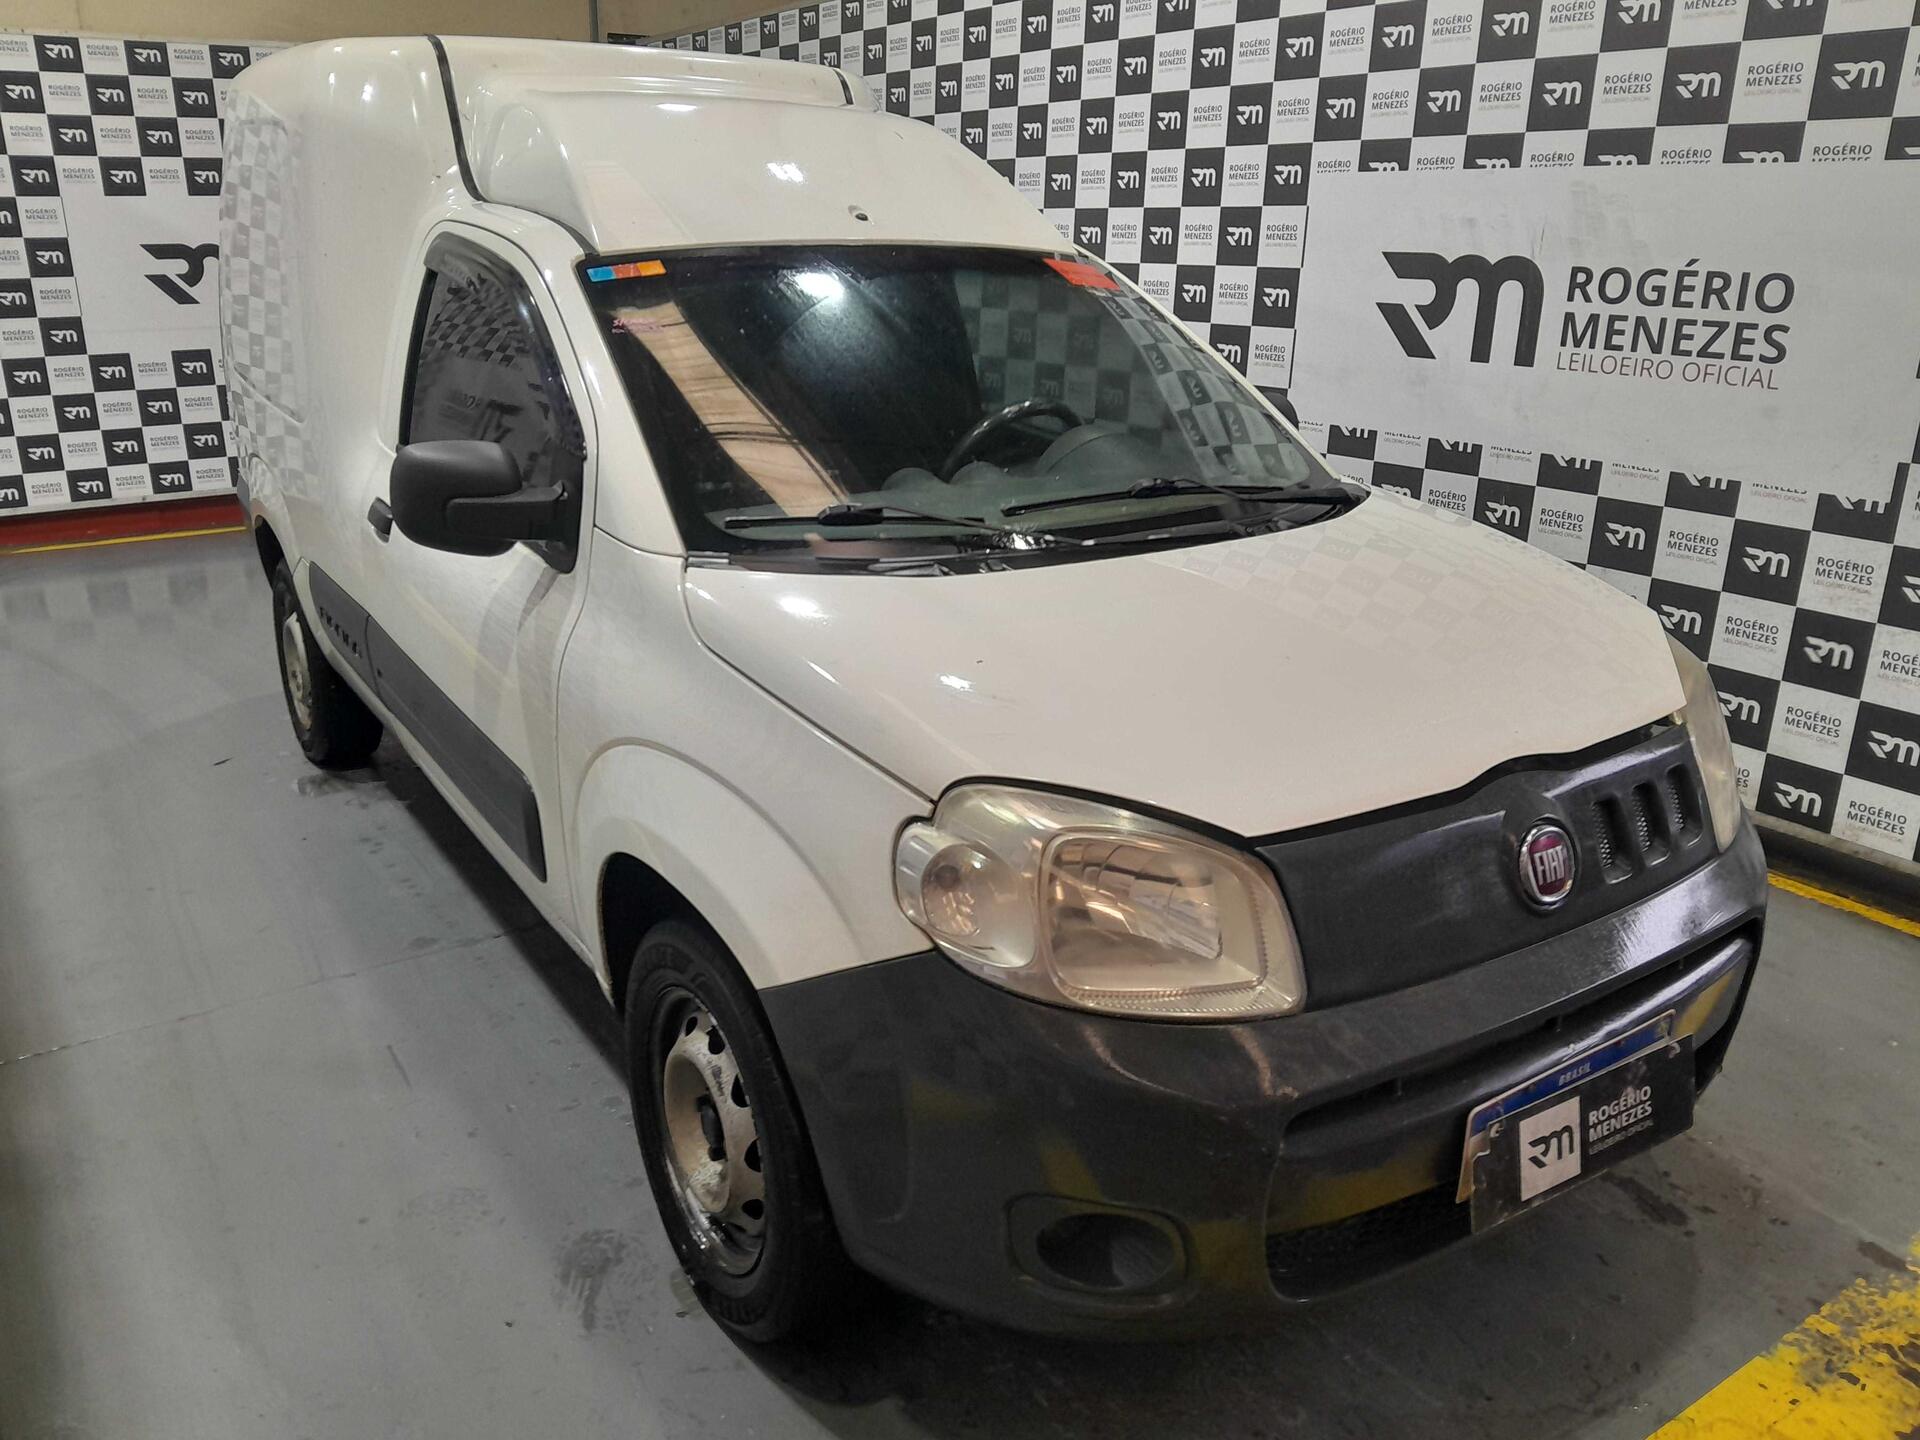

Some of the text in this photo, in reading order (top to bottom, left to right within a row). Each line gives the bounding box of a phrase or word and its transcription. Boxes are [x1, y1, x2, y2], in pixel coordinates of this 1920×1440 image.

[1550, 0, 1596, 13] ROGÉRIO
[1433, 13, 1473, 26] ROGÉRIO
[1549, 9, 1595, 24] MENEZES
[1330, 25, 1365, 38] ROGÉRIO
[1432, 22, 1472, 36] MENEZES
[1239, 37, 1271, 49] ROGÉRIO
[1329, 34, 1364, 47] MENEZES
[1159, 47, 1187, 58] ROGÉRIO
[1239, 46, 1270, 57] MENEZES
[1087, 57, 1112, 67] ROGÉRIO
[1159, 56, 1186, 66] MENEZES
[1087, 65, 1112, 74] MENEZES
[1747, 60, 1805, 75] ROGÉRIO
[1604, 71, 1653, 84] ROGÉRIO
[1745, 72, 1803, 87] MENEZES
[1480, 80, 1523, 92] ROGÉRIO
[1602, 81, 1652, 95] MENEZES
[1372, 89, 1410, 100] ROGÉRIO
[1479, 90, 1522, 102] MENEZES
[1277, 97, 1310, 107] ROGÉRIO
[1371, 98, 1409, 110] MENEZES
[1119, 110, 1145, 119] ROGÉRIO
[1194, 104, 1223, 114] ROGÉRIO
[1277, 105, 1310, 116] MENEZES
[1118, 118, 1144, 127] MENEZES
[1193, 113, 1222, 122] MENEZES
[1661, 147, 1713, 159] ROGÉRIO
[1813, 142, 1874, 155] ROGÉRIO
[1417, 155, 1456, 165] ROGÉRIO
[1530, 151, 1575, 162] ROGÉRIO
[1151, 165, 1178, 174] ROGÉRIO
[1229, 162, 1260, 171] ROGÉRIO
[1317, 159, 1352, 168] ROGÉRIO
[1081, 168, 1106, 176] ROGÉRIO
[1151, 173, 1178, 182] MENEZES
[1229, 171, 1259, 180] MENEZES
[1081, 176, 1106, 184] MENEZES
[1112, 223, 1137, 231] ROGÉRIO
[1185, 223, 1213, 231] ROGÉRIO
[1266, 223, 1298, 232] ROGÉRIO
[1111, 231, 1137, 239] MENEZES
[1266, 232, 1298, 240] MENEZES
[1143, 279, 1170, 287] ROGÉRIO
[1219, 282, 1249, 291] ROGÉRIO
[1566, 258, 1795, 313] ROGÉRIO
[1219, 290, 1248, 299] MENEZES
[1560, 312, 1791, 364] MENEZES
[1255, 343, 1286, 353] ROGÉRIO
[1254, 351, 1285, 362] MENEZES
[1556, 351, 1779, 390] LEILOEIRO OFICIAL
[1428, 488, 1467, 502] ROGÉRIO
[1427, 497, 1466, 511] MENEZES
[1540, 507, 1585, 522] ROGÉRIO
[1539, 516, 1583, 532] MENEZES
[1669, 529, 1719, 546] ROGÉRIO
[1667, 539, 1718, 557] MENEZES
[1816, 555, 1875, 575] ROGÉRIO
[1814, 566, 1873, 586] MENEZES
[1726, 615, 1780, 635] ROGÉRIO
[1724, 625, 1778, 645] MENEZES
[1882, 649, 1920, 666] ROGÉ
[1786, 705, 1843, 727] ROGÉRIO
[1784, 715, 1841, 738] MENEZES
[1849, 799, 1908, 825] ROGÉRIO
[1846, 810, 1906, 835] MENEZES
[1534, 845, 1564, 885] FIAT
[1589, 1085, 1651, 1126] ROGÉRIO
[1589, 1101, 1652, 1142] MENEZES
